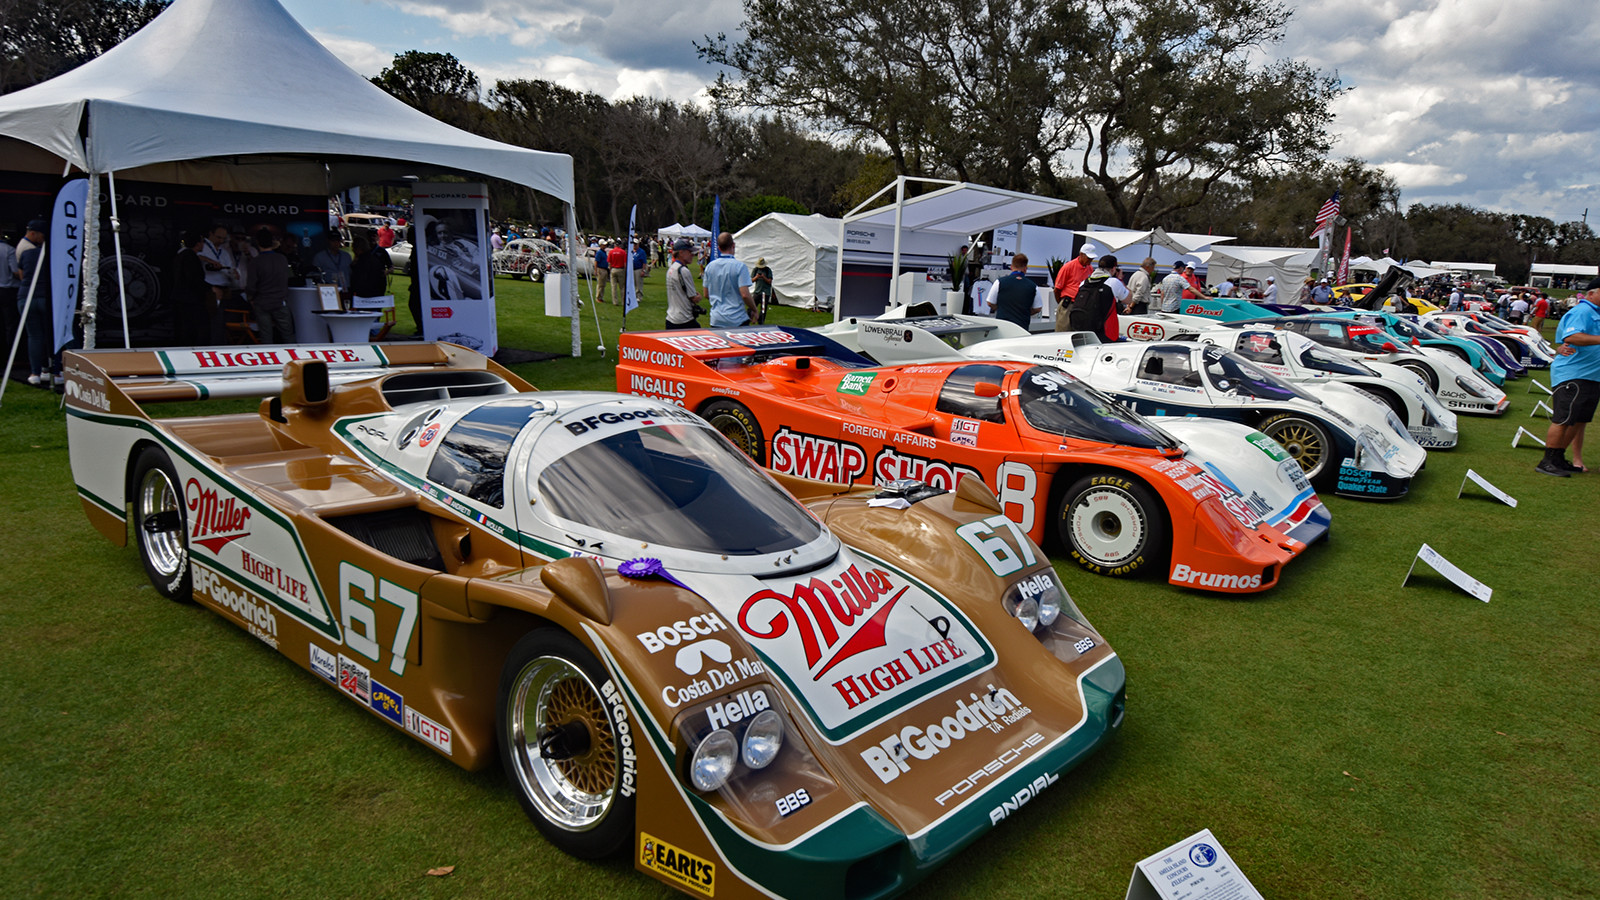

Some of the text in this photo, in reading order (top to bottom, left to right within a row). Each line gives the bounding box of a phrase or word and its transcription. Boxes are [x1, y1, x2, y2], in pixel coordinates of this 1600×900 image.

[99, 193, 168, 208] OPARD
[224, 203, 300, 216] CHOPARD
[192, 348, 360, 368] HIGH LIFE
[622, 346, 685, 368] SNOW CONST.
[1033, 354, 1072, 364] ANDIAL
[65, 366, 105, 386] PORSCHE
[630, 374, 686, 399] INGALLS
[840, 381, 864, 393] Bank
[842, 373, 874, 384] Barnett
[1440, 390, 1468, 399] SACHS
[1448, 400, 1484, 409] Shell
[732, 408, 758, 459] GOODYE
[842, 422, 937, 449] FOREIGN AFFAIRS
[963, 422, 979, 432] GT
[951, 436, 975, 446] CAMEL
[1091, 476, 1133, 490] EAGLE
[1338, 475, 1382, 485] GOODYEAR
[1339, 467, 1372, 478] BOSCH
[1337, 480, 1388, 494] Quaker State
[186, 477, 252, 538] Miller
[450, 501, 472, 516] ANDRETTI
[955, 514, 1038, 577] 67
[1075, 515, 1093, 551] PORSCHE
[241, 549, 309, 603] HIGH LIFE
[1017, 574, 1054, 600] Hella
[1171, 563, 1262, 589] Brumos
[191, 563, 278, 637] BFGoodrich
[339, 560, 419, 678] 67
[737, 563, 894, 671] Miller
[636, 612, 728, 654] BOSCH
[1073, 636, 1096, 654] BBS
[341, 669, 358, 695] 24
[662, 678, 711, 708] Costa
[707, 663, 740, 691] Del
[832, 637, 965, 710] HIGH LIFE
[705, 689, 770, 731] Hella
[985, 706, 1032, 734] T/A Radials
[421, 719, 451, 745] GTP
[600, 678, 637, 798] BFGoodrich
[859, 683, 1023, 785] BFGoodrich
[934, 732, 1046, 807] PORSCHE
[775, 788, 812, 817] BBS
[989, 772, 1060, 827] ANDIAL
[656, 843, 713, 885] EARL'S
